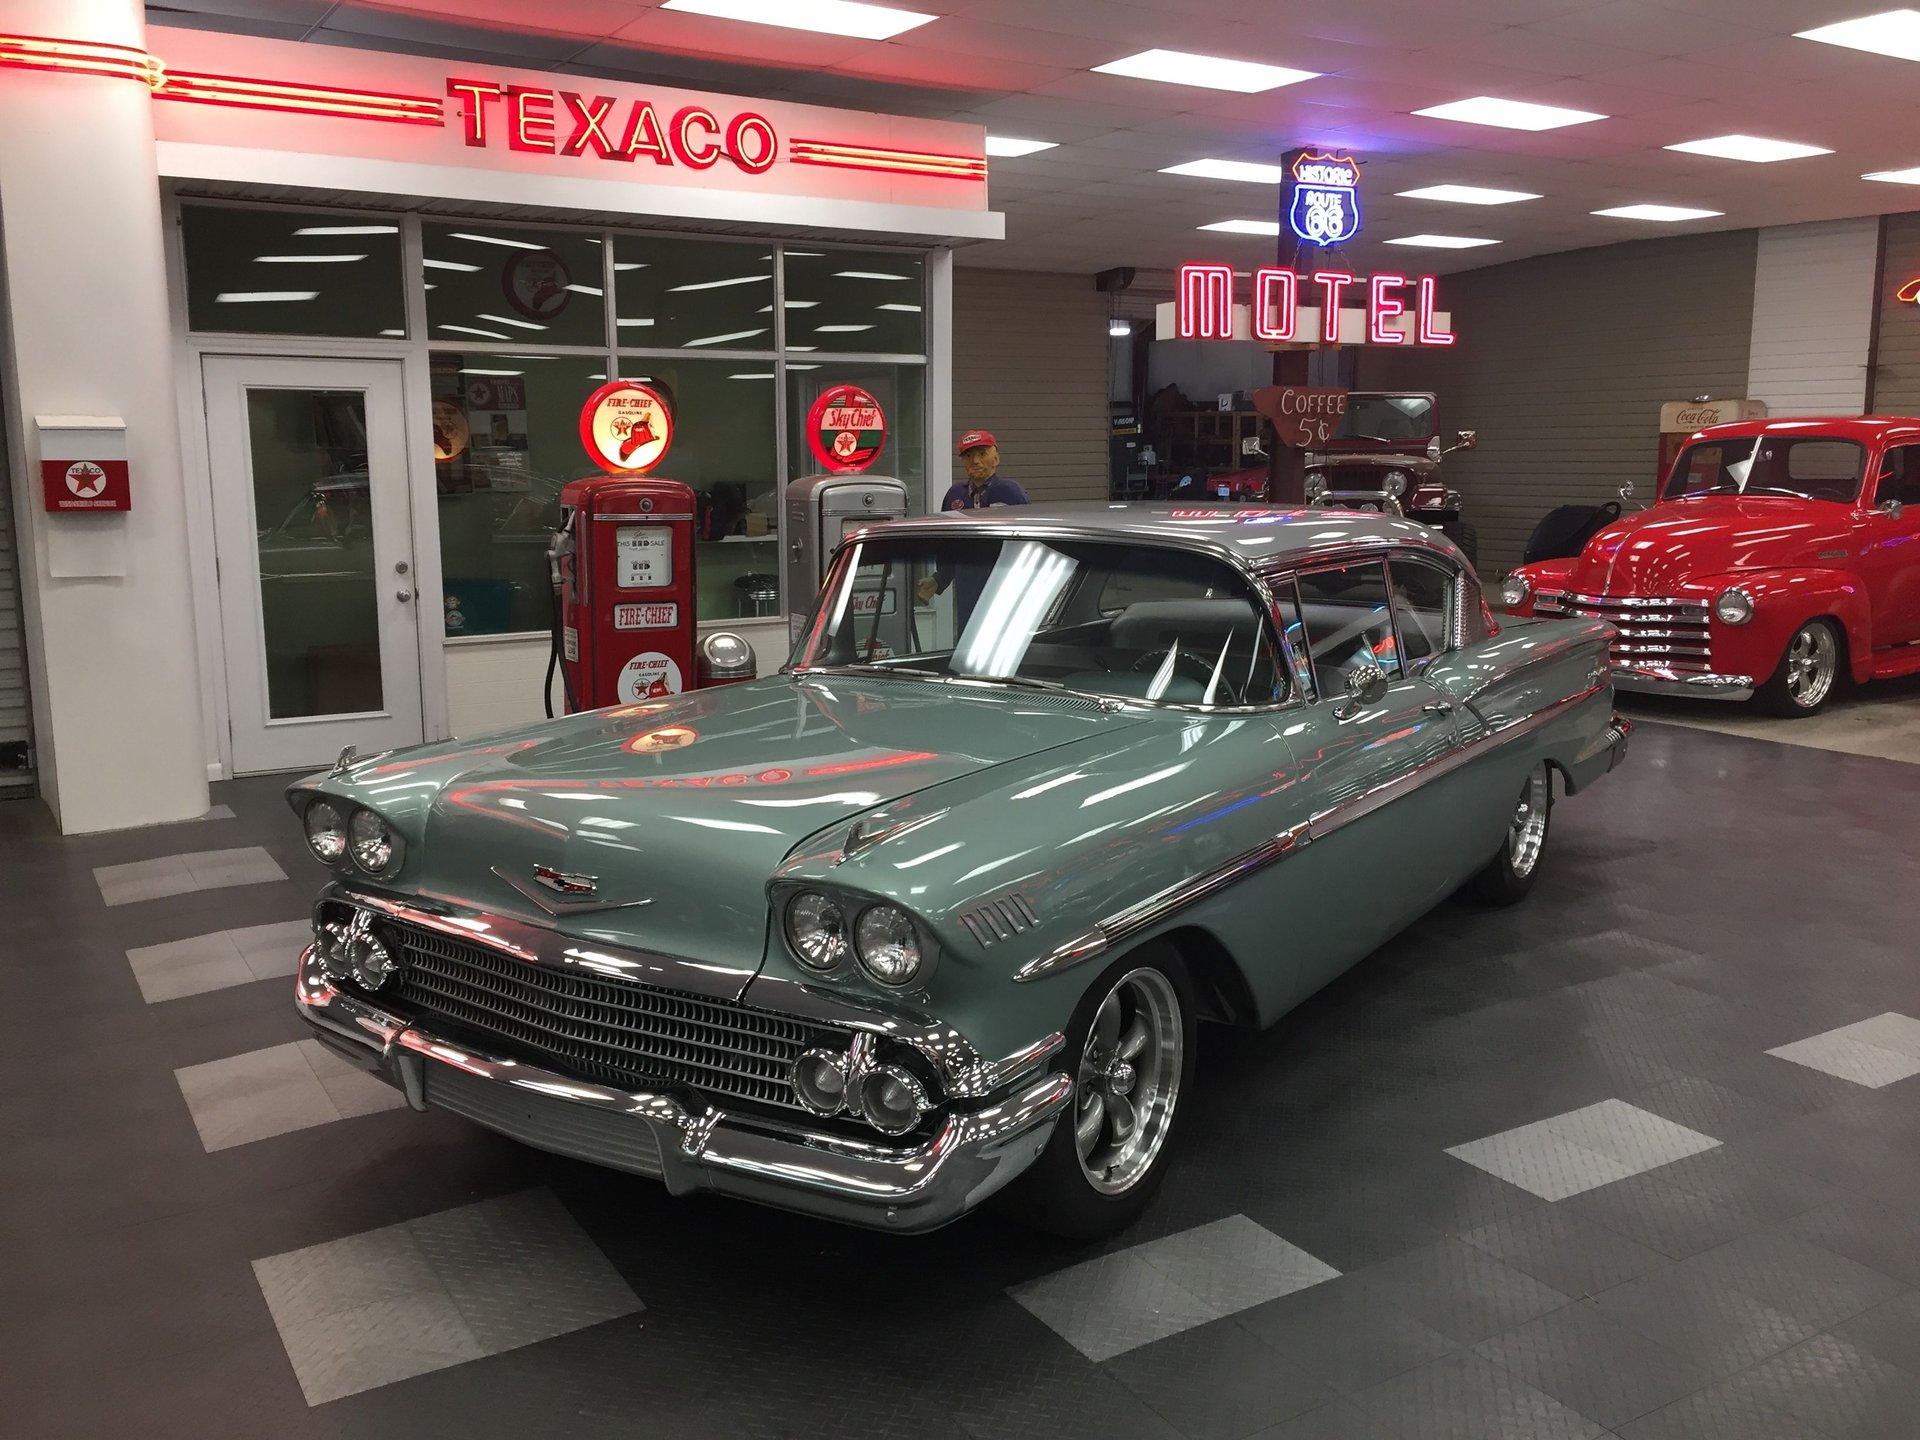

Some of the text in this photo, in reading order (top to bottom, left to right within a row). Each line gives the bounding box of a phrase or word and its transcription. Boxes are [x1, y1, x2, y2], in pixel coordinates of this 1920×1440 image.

[446, 77, 778, 175] TEXACO
[1299, 165, 1353, 186] HISTORIC
[1305, 190, 1343, 207] ROUTE
[1305, 206, 1344, 237] 66
[1177, 264, 1455, 345] MOTEL
[607, 398, 653, 408] FIRE-CHIEF
[1281, 389, 1345, 415] COFFEE
[829, 408, 877, 429] Sky Chief
[1676, 408, 1721, 425] Coca-Cola
[619, 606, 674, 626] FIRE-CHIEF
[629, 659, 670, 670] FIRE-CHIEF
